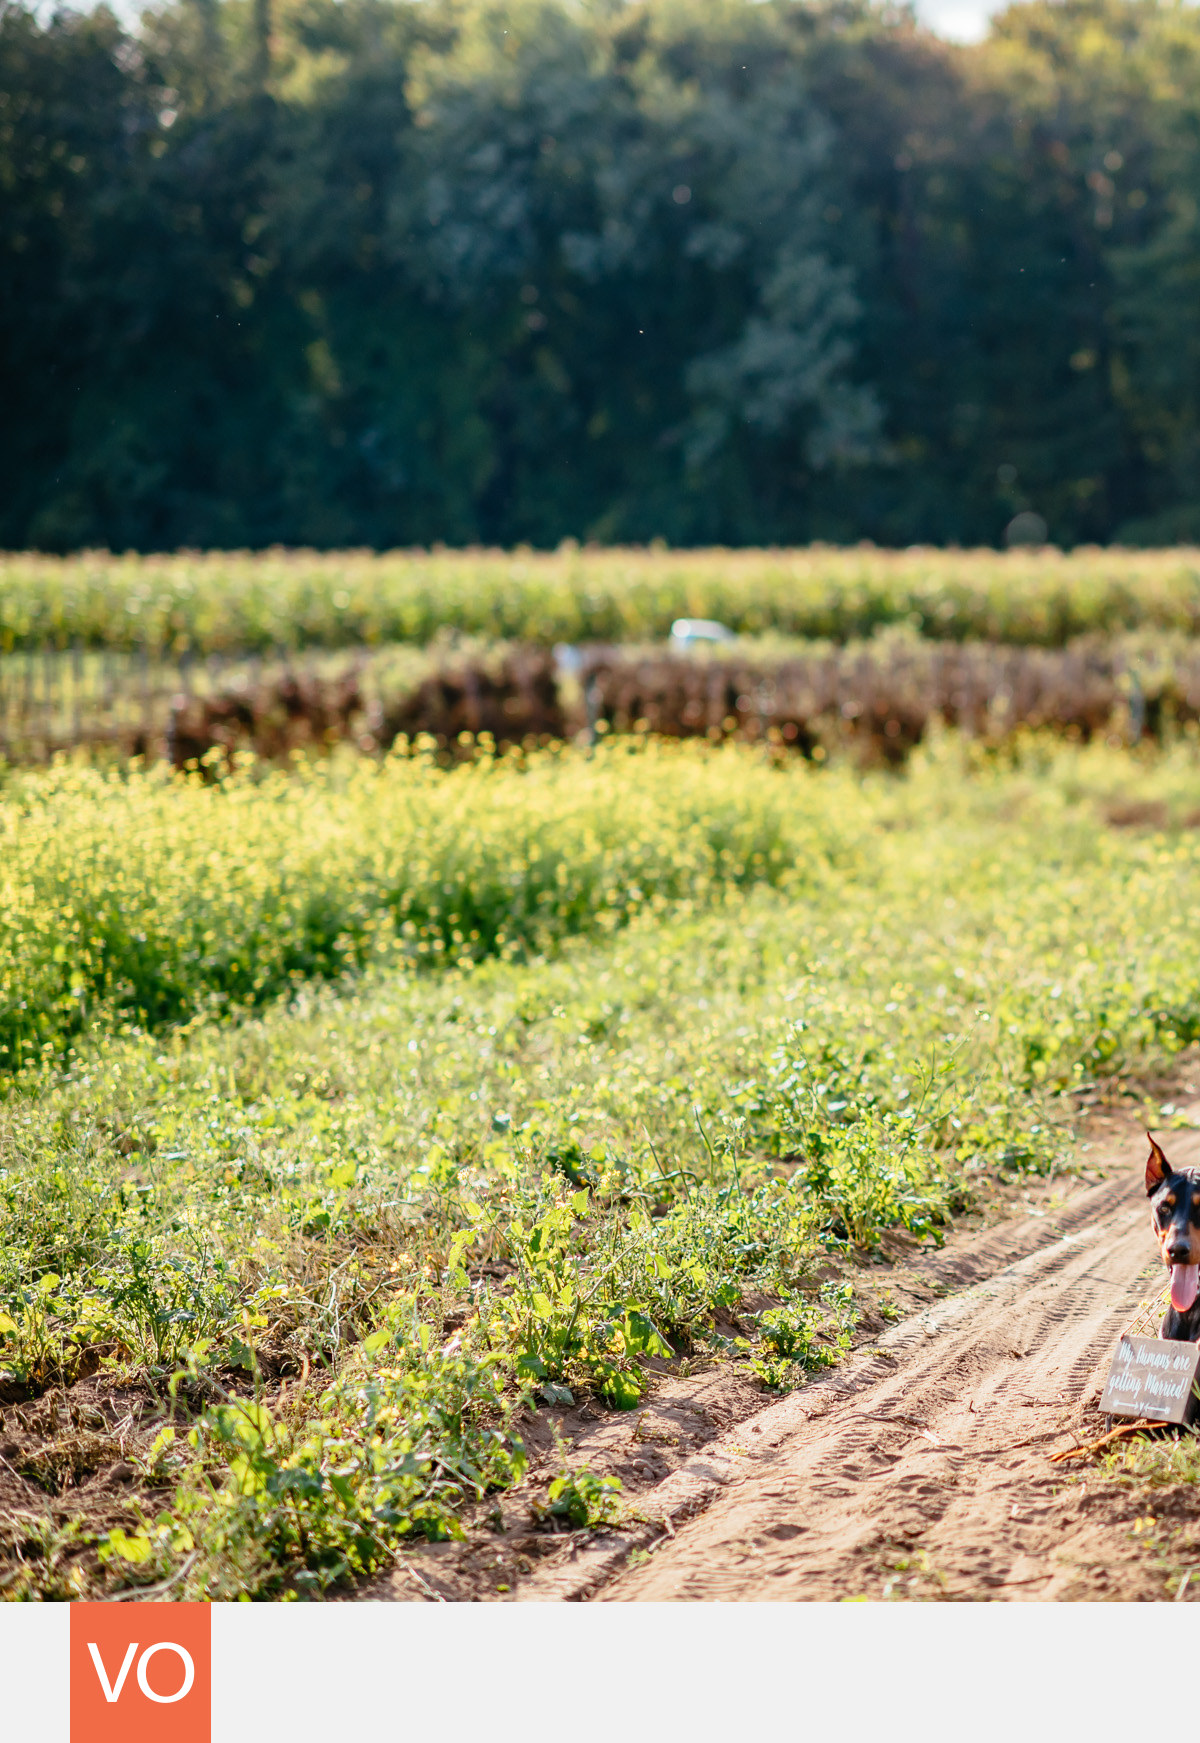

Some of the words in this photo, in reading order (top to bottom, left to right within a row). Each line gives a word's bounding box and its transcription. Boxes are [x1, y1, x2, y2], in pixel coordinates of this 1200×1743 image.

[1119, 1341, 1135, 1370] My
[1173, 1355, 1191, 1371] are
[1107, 1371, 1141, 1399] getting
